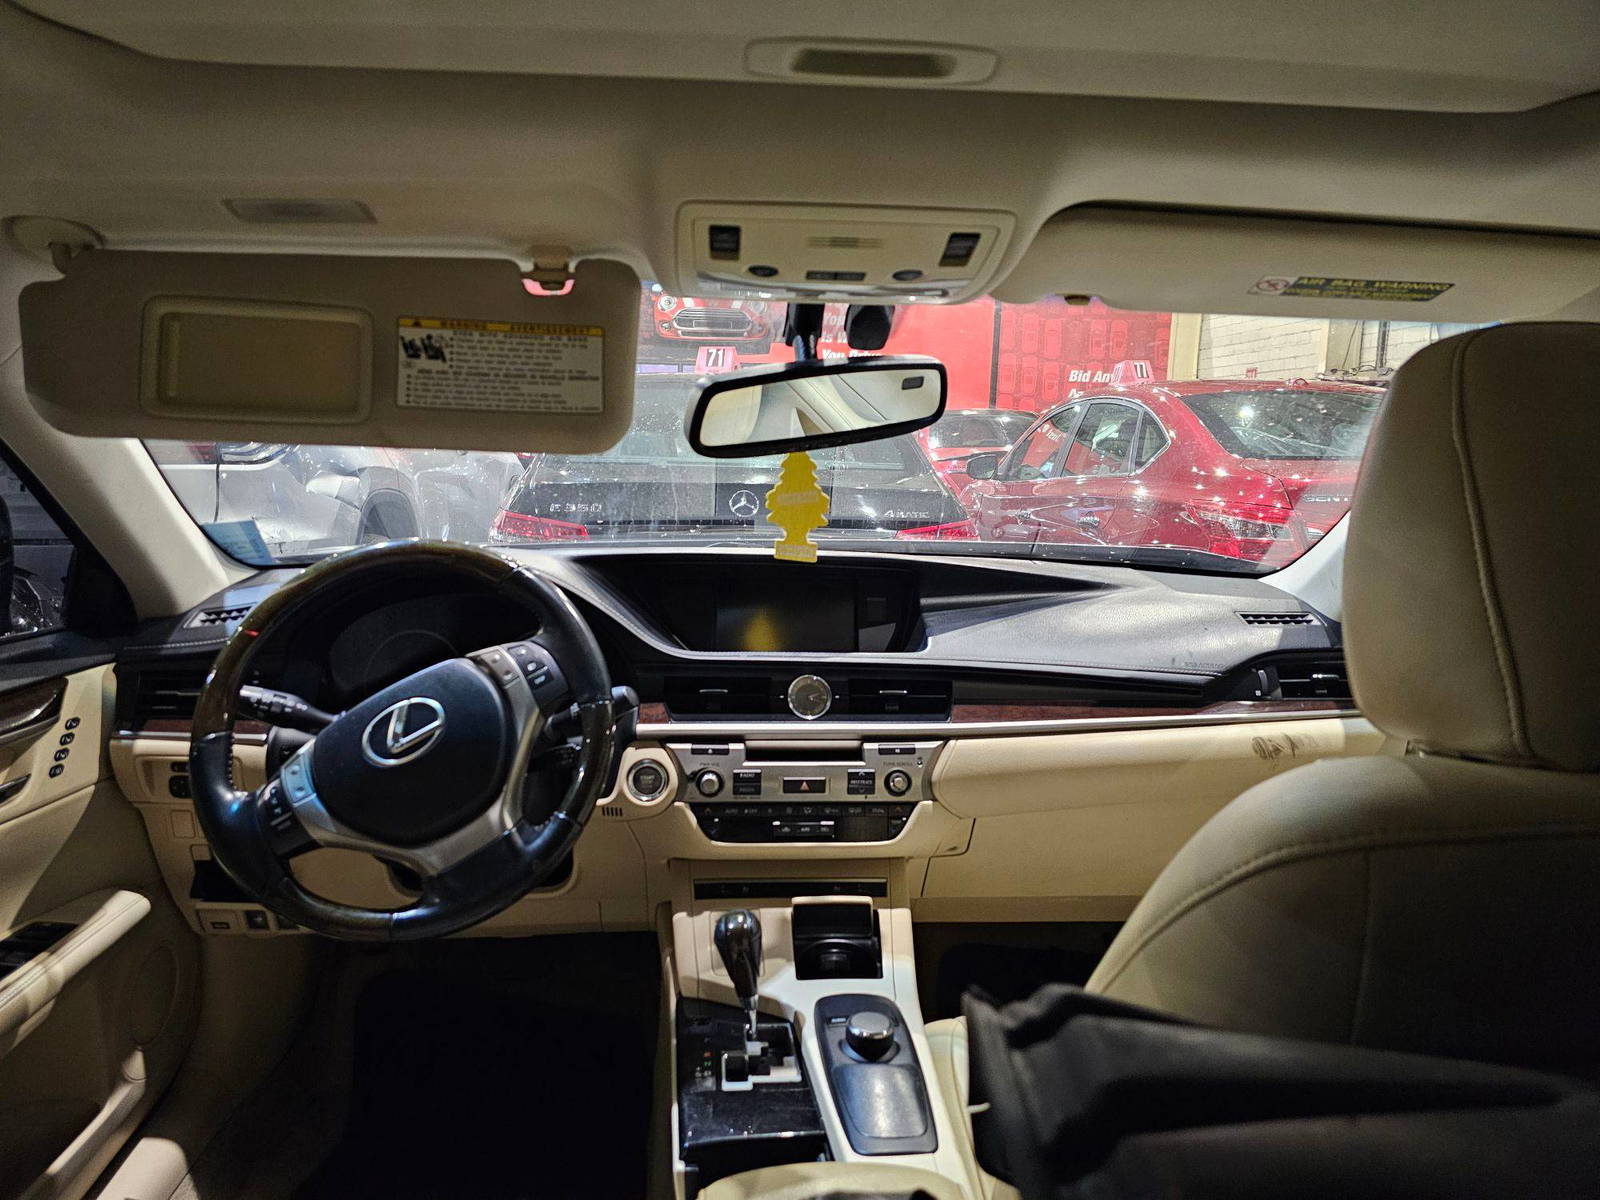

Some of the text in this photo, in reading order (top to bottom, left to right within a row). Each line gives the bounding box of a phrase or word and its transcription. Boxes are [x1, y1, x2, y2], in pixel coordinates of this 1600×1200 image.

[708, 349, 724, 367] 71
[1068, 370, 1091, 382] Bid
[883, 509, 930, 519] 4MATIC
